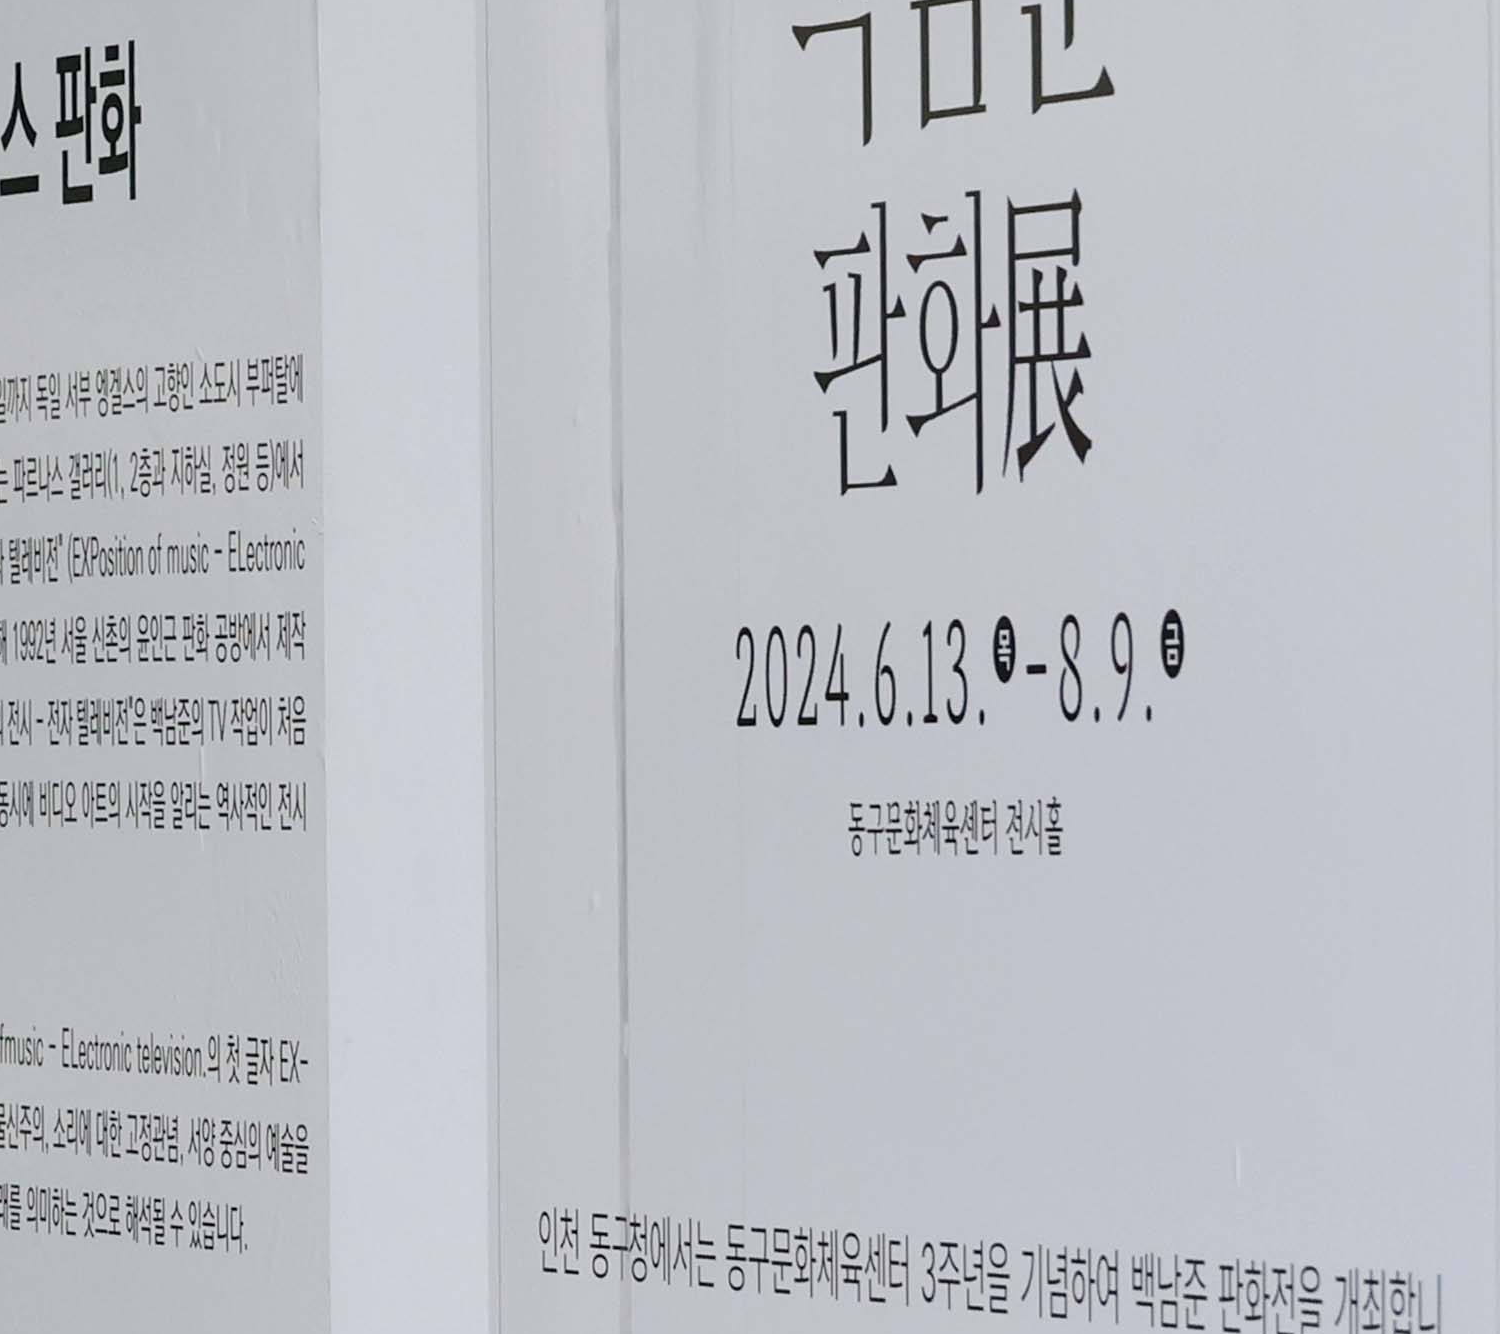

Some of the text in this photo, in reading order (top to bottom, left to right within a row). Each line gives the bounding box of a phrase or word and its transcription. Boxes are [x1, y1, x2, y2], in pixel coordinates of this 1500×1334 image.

[55, 40, 142, 205] 판화
[813, 188, 1092, 496] 판화展
[36, 372, 61, 421] 독일
[65, 371, 92, 418] 서부
[95, 365, 148, 417] 엥겔스의
[153, 362, 194, 413] 고향인
[199, 359, 240, 407] 소도시
[246, 354, 303, 406] 부퍼탈에
[13, 455, 64, 503] 파르나스
[129, 447, 166, 498] 2층과
[221, 443, 250, 494] 정원
[255, 439, 303, 492] 등)에서
[148, 533, 162, 575] of
[167, 532, 209, 574] music
[228, 528, 305, 572] ELectronic
[13, 618, 56, 664] 1992년
[61, 616, 88, 664] 서울
[92, 615, 131, 663] 신촌의
[182, 613, 210, 662] 판화
[214, 612, 270, 663] 공방에서
[276, 611, 306, 660] 제작
[39, 780, 78, 827] 비디오
[82, 780, 121, 828] 아트의
[125, 780, 166, 829] 시작을
[170, 781, 212, 831] 알리는
[216, 782, 272, 832] 역사적인
[278, 782, 306, 831] 전시
[848, 796, 1063, 857] 동구문화체육센터 전시홀
[62, 1027, 132, 1073] ELectronic
[226, 1034, 240, 1084] 첫
[245, 1037, 275, 1086] 글자
[52, 1108, 92, 1157] 소리에
[96, 1110, 123, 1158] 대한
[187, 1117, 216, 1167] 서양
[219, 1120, 261, 1171] 중심의
[266, 1123, 310, 1174] 예술을
[26, 1186, 78, 1236] 의미하는
[82, 1191, 122, 1238] 것으로
[125, 1195, 166, 1246] 해석될
[170, 1199, 184, 1247] 수
[539, 1207, 579, 1275] 인천
[589, 1213, 716, 1288] 동구청에서는
[725, 1224, 909, 1307] 동구문화체육센터
[921, 1240, 1011, 1314] 3주년을
[1021, 1244, 1119, 1324] 기념하여
[1132, 1253, 1208, 1330] 백남준
